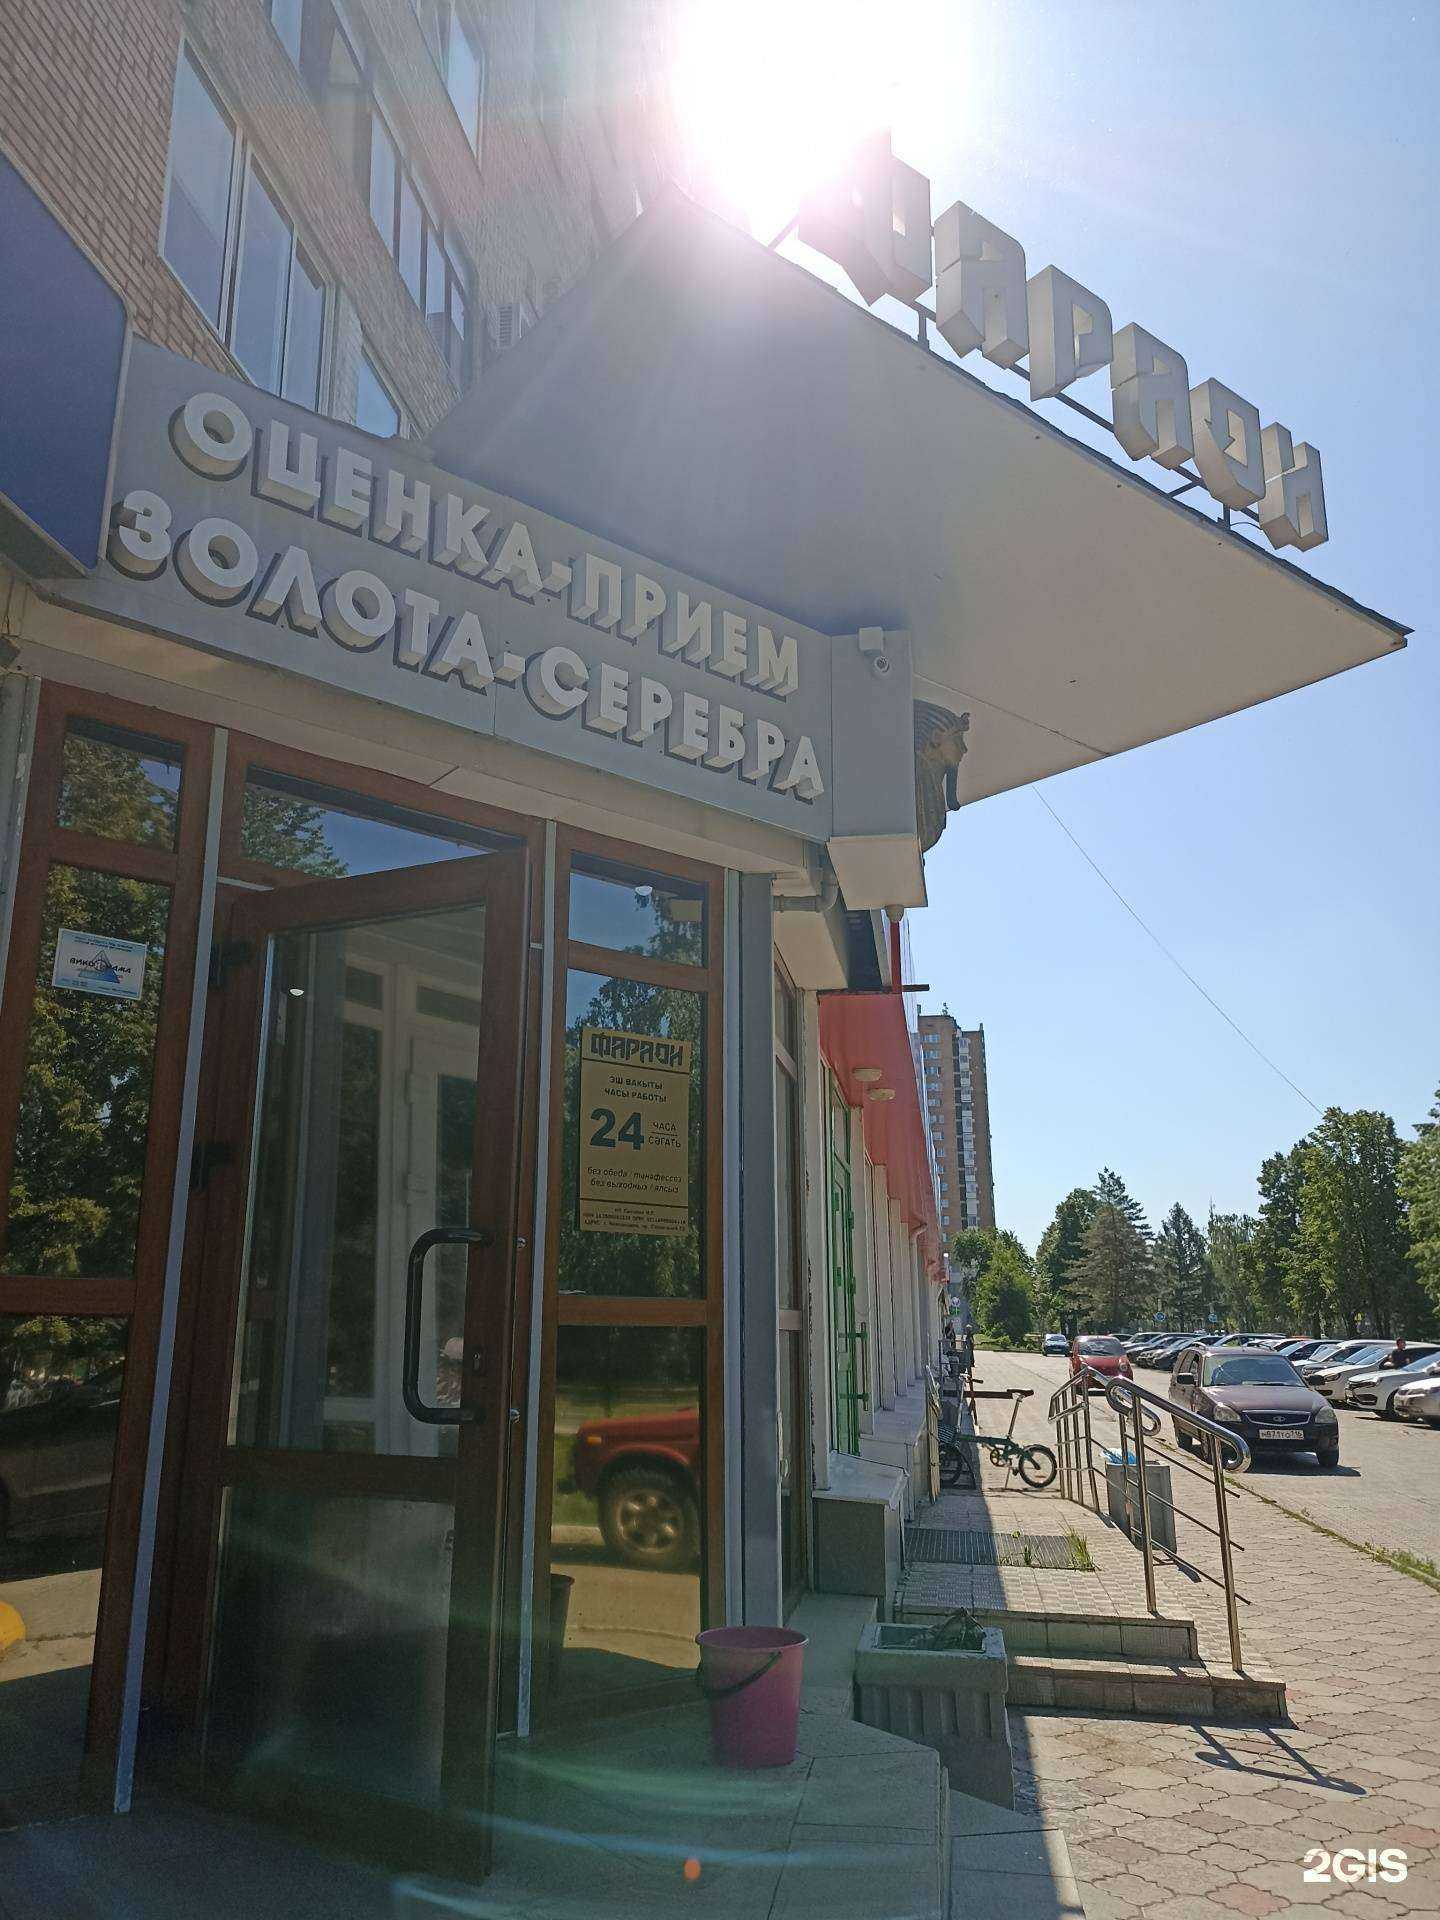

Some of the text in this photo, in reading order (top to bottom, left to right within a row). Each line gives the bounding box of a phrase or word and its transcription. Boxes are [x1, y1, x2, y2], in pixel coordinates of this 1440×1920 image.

[170, 393, 799, 698] ОЦЕНКА-ПРИЕМ
[114, 490, 826, 800] ЗОЛОТА-СЕРЕБРА
[590, 1108, 677, 1151] 24 ЧАСА
[604, 1088, 667, 1102] ЧАСЫ РАБОТЫ
